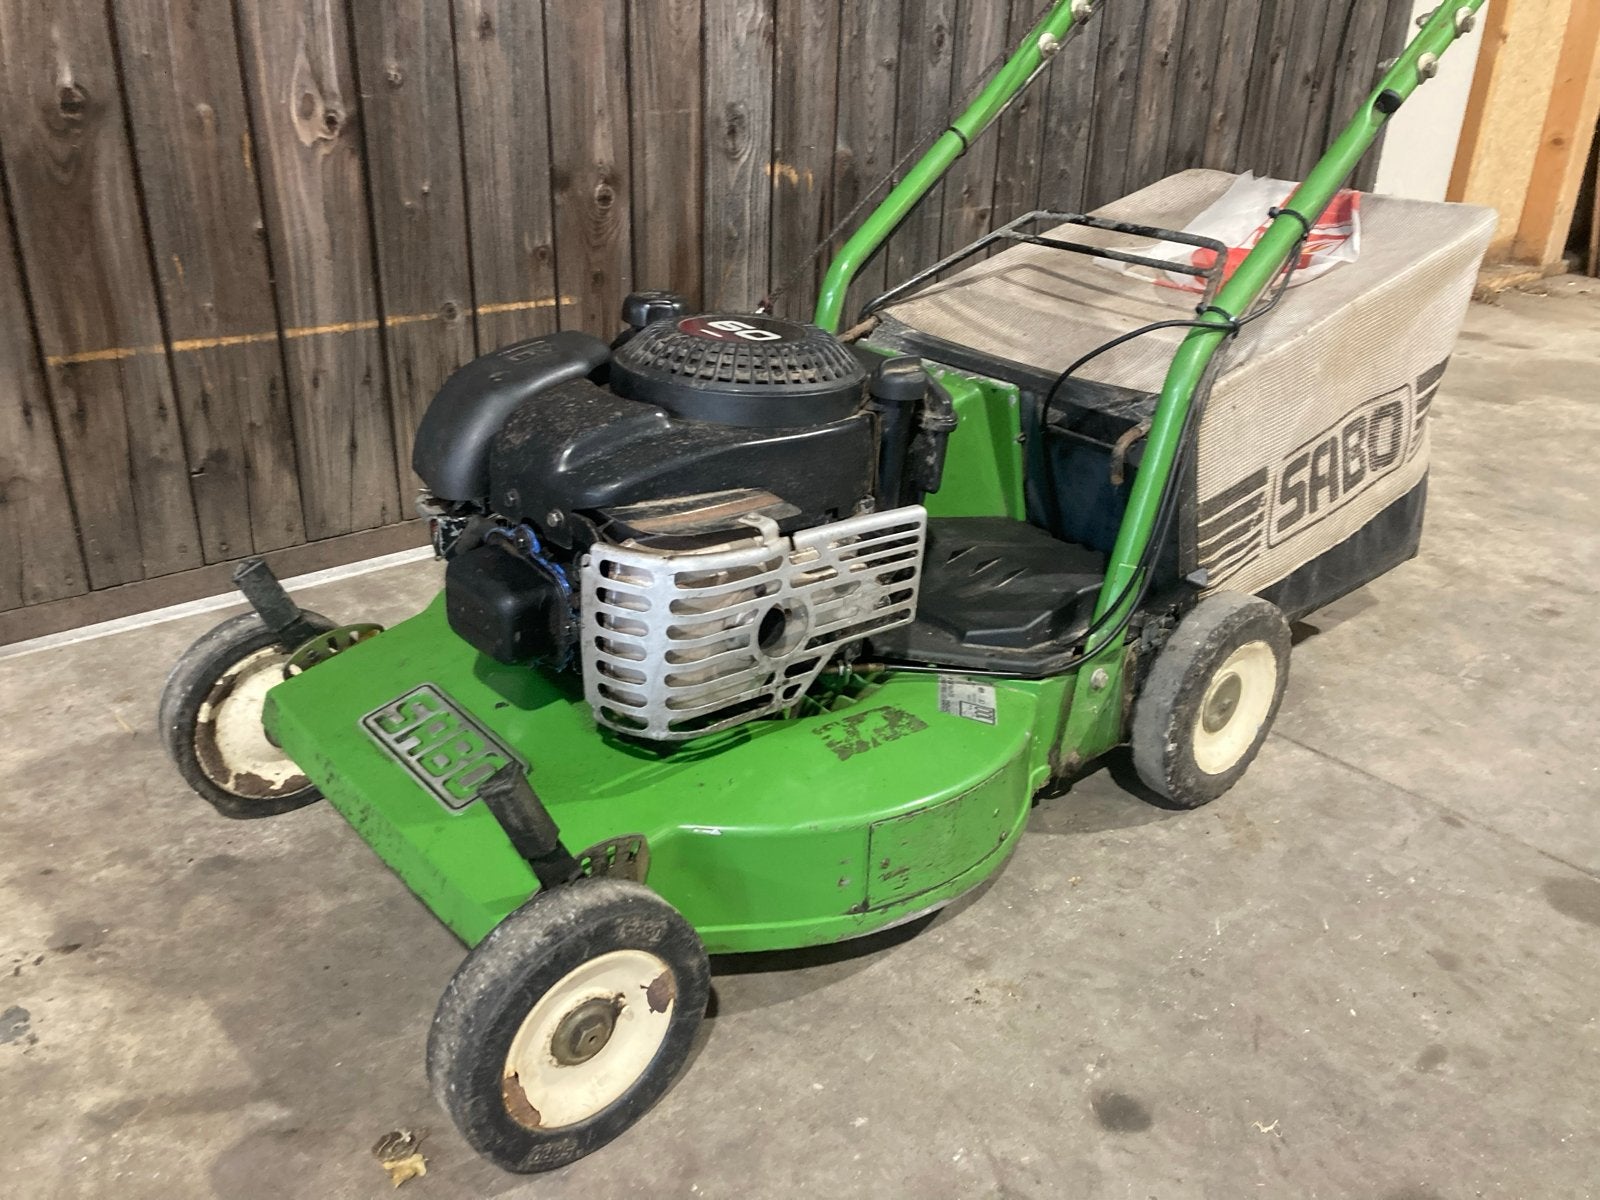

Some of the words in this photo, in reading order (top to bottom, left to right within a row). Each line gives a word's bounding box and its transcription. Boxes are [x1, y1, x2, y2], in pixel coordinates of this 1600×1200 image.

[706, 320, 782, 341] 60
[1276, 400, 1405, 535] SABO
[373, 692, 509, 800] SABO
